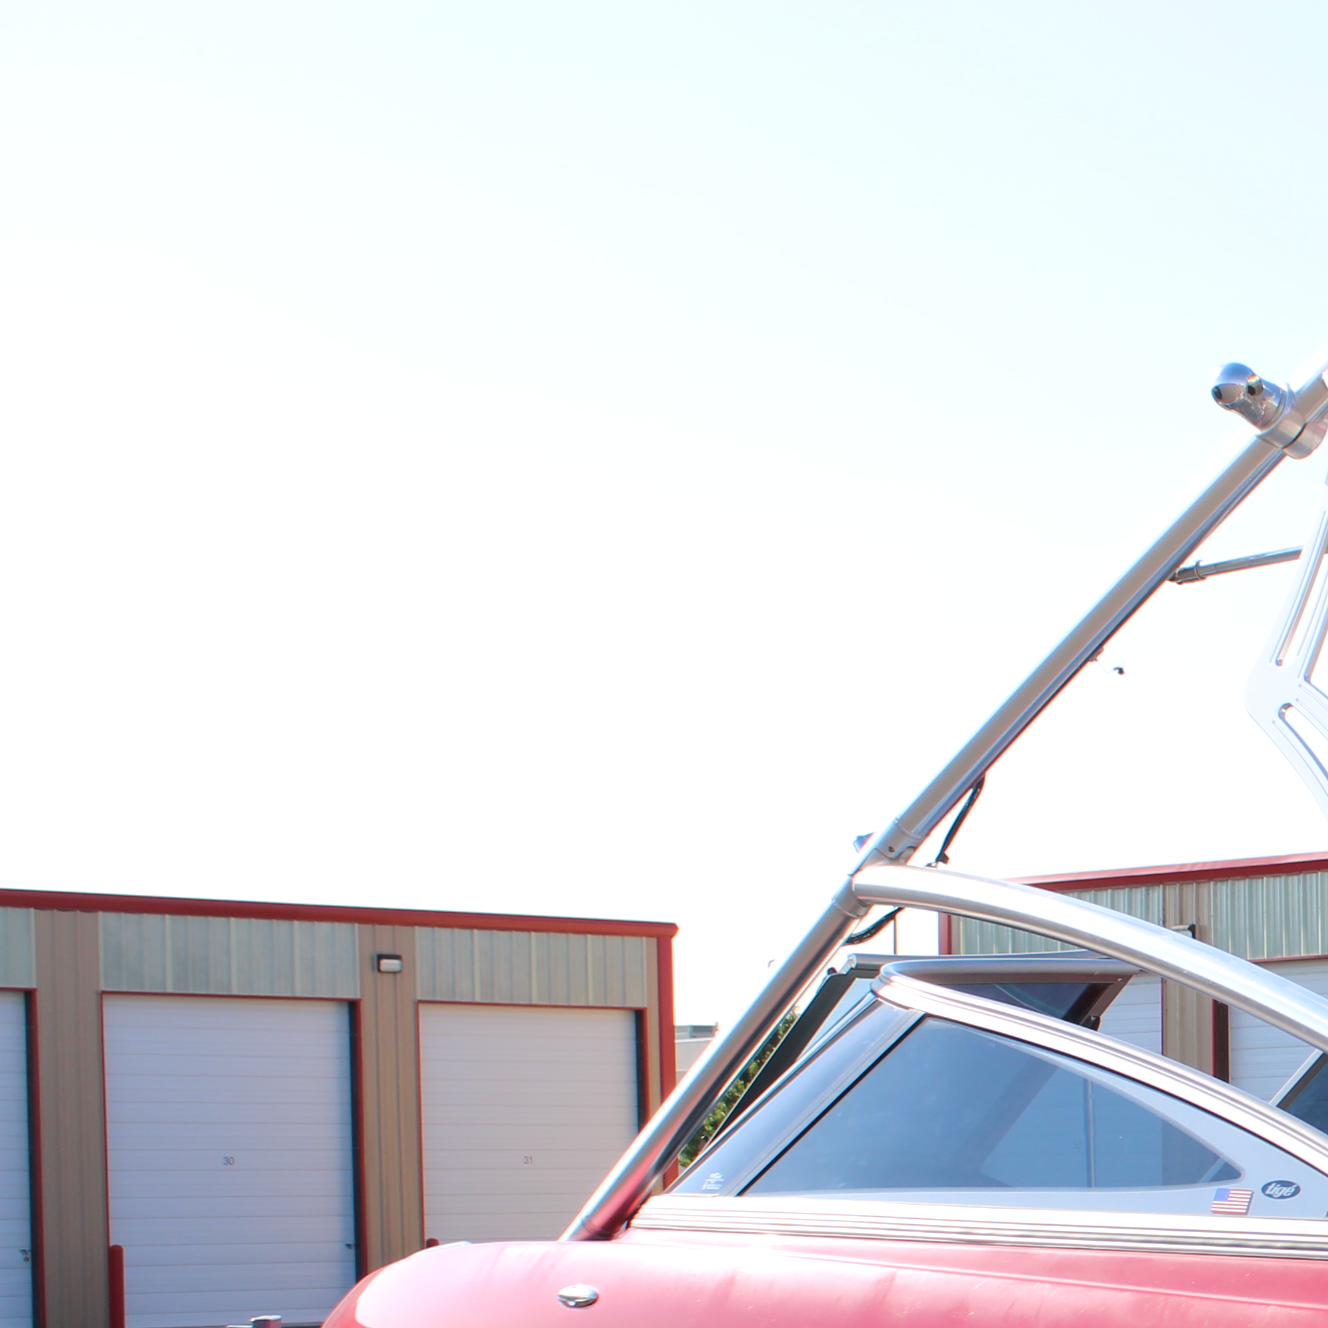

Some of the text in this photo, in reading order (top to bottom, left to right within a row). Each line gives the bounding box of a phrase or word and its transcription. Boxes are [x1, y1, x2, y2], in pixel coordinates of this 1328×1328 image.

[223, 1156, 235, 1166] 30
[523, 1155, 533, 1165] 31
[1265, 1183, 1298, 1198] tigé
